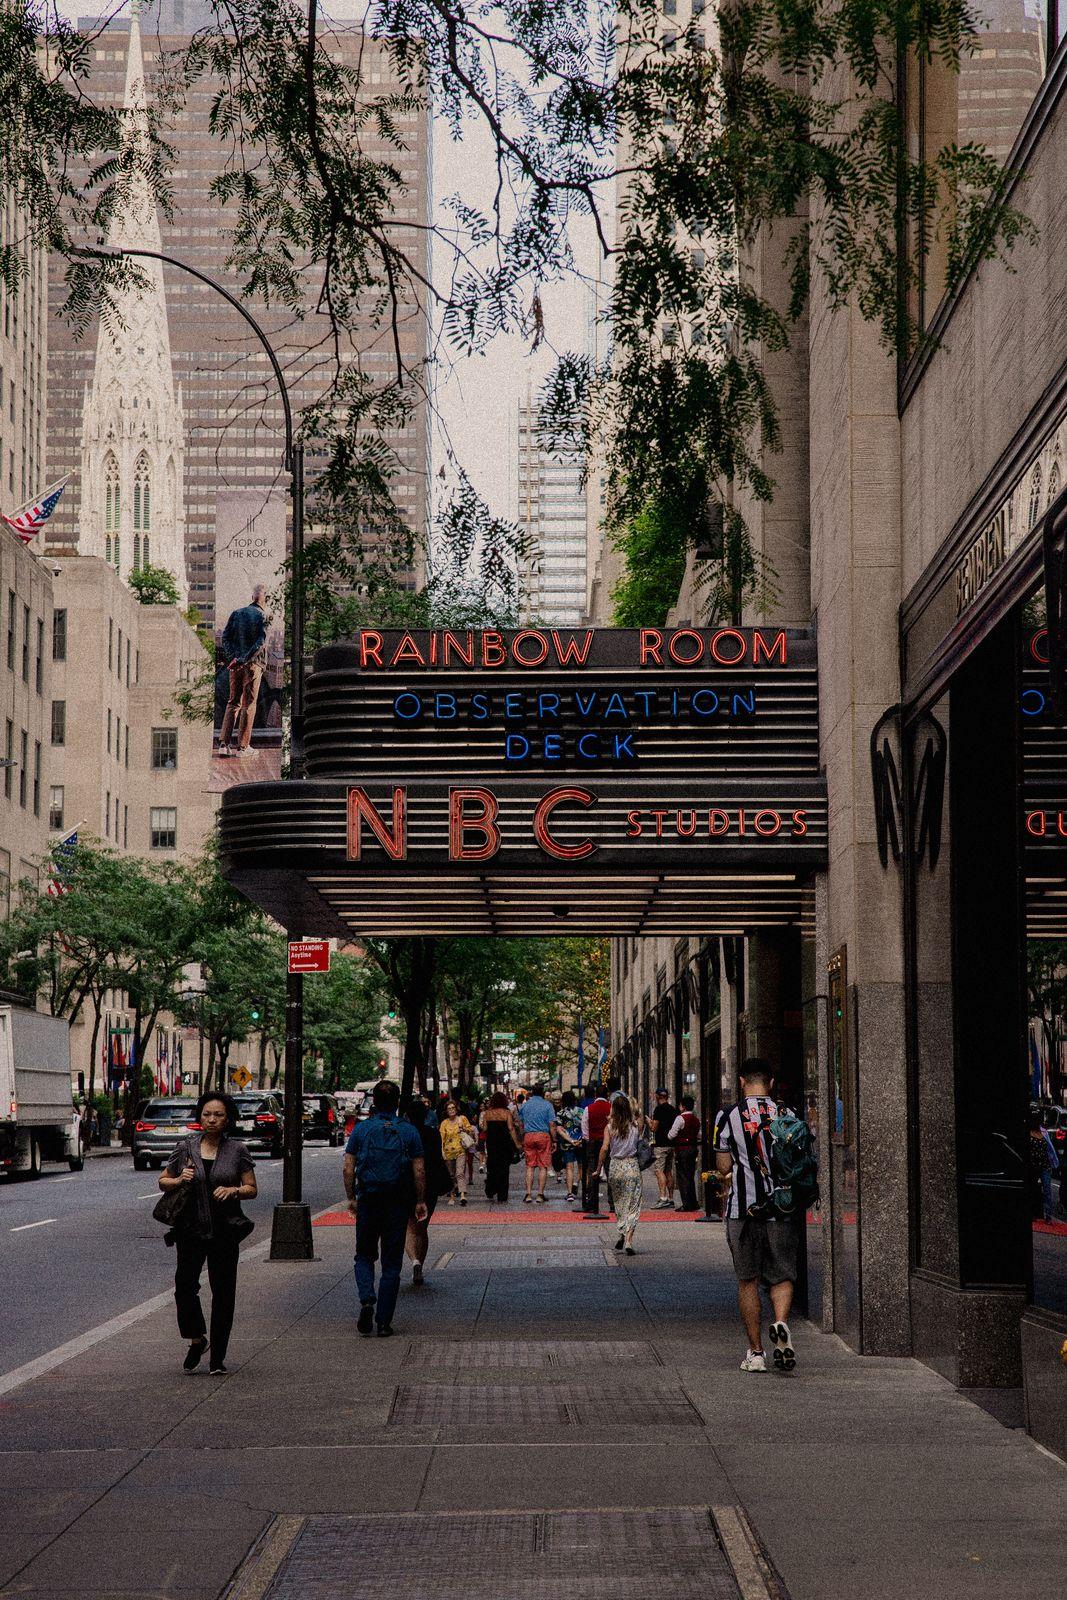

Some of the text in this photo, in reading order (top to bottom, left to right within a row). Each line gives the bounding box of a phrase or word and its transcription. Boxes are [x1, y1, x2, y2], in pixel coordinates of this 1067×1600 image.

[227, 549, 273, 558] THE ROCK
[234, 538, 268, 547] TOP OF
[359, 627, 788, 668] RAINBOW ROOM
[393, 688, 756, 719] OBSERVATION
[505, 733, 639, 760] DECK
[345, 784, 808, 862] NBC STUDIOS
